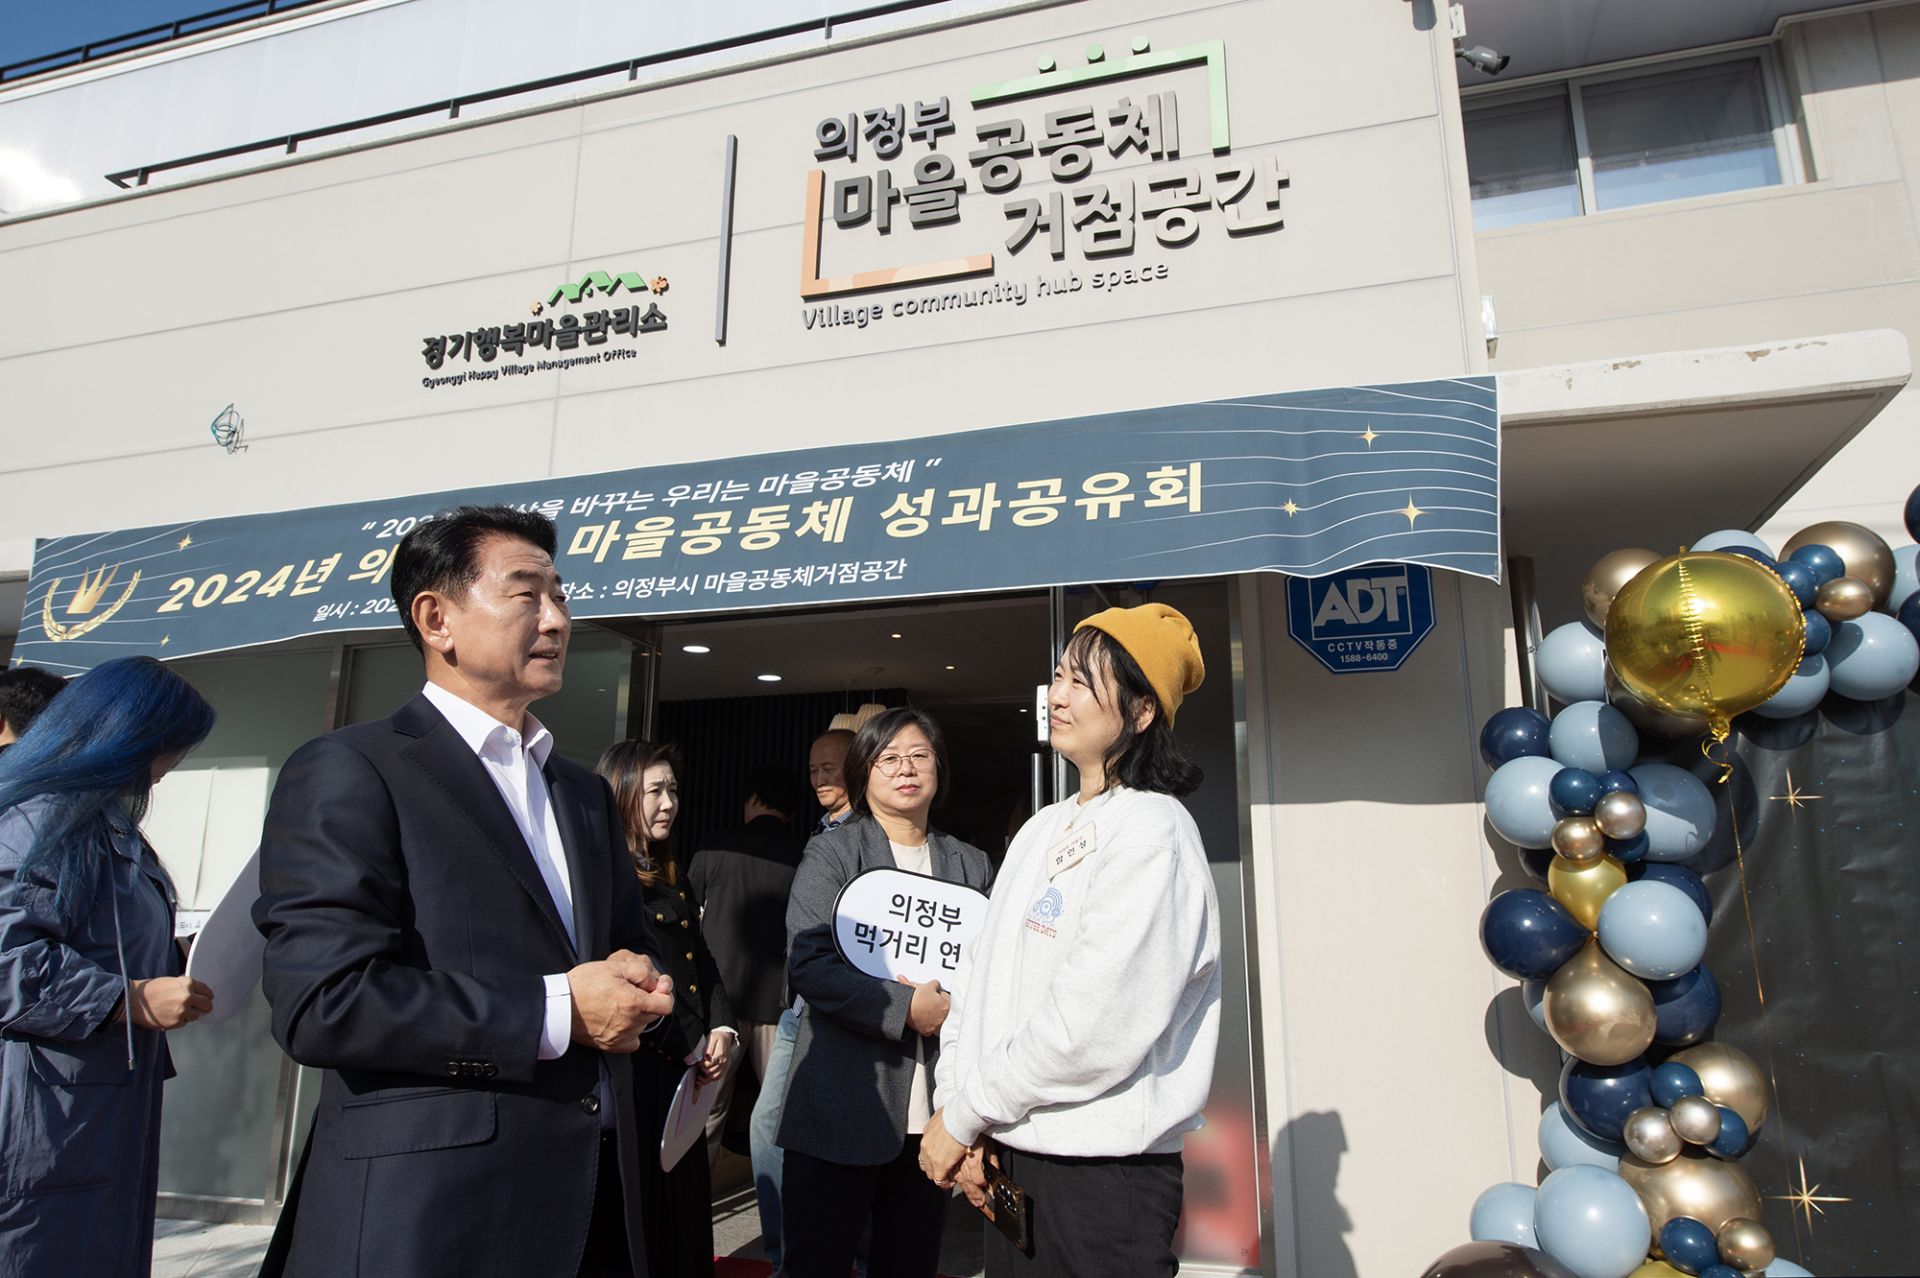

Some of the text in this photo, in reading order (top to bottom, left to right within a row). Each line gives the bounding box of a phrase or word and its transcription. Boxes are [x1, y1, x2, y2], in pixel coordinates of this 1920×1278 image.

[813, 95, 955, 162] 의정부
[1003, 154, 1290, 261] 거점공간
[801, 260, 1169, 330] Village community hub space
[421, 302, 668, 370] 경기행복마을관리소
[421, 347, 638, 389] Gyeonggi Happy Village Management Office
[569, 488, 655, 518] 바꾸는
[661, 480, 751, 509] 우리는
[758, 459, 915, 496] 마을공동체
[156, 552, 343, 614] 2024년
[566, 496, 854, 564] 마을공동체
[879, 461, 1202, 539] 성과공유회
[359, 598, 399, 617] 202
[611, 574, 699, 600] 의정부시
[703, 558, 908, 594] 마을공동체거점공간
[1313, 576, 1407, 627] ADT
[1340, 653, 1388, 663] 1588-6400
[888, 893, 962, 932] 의정부
[854, 922, 962, 971] 먹거리 연
